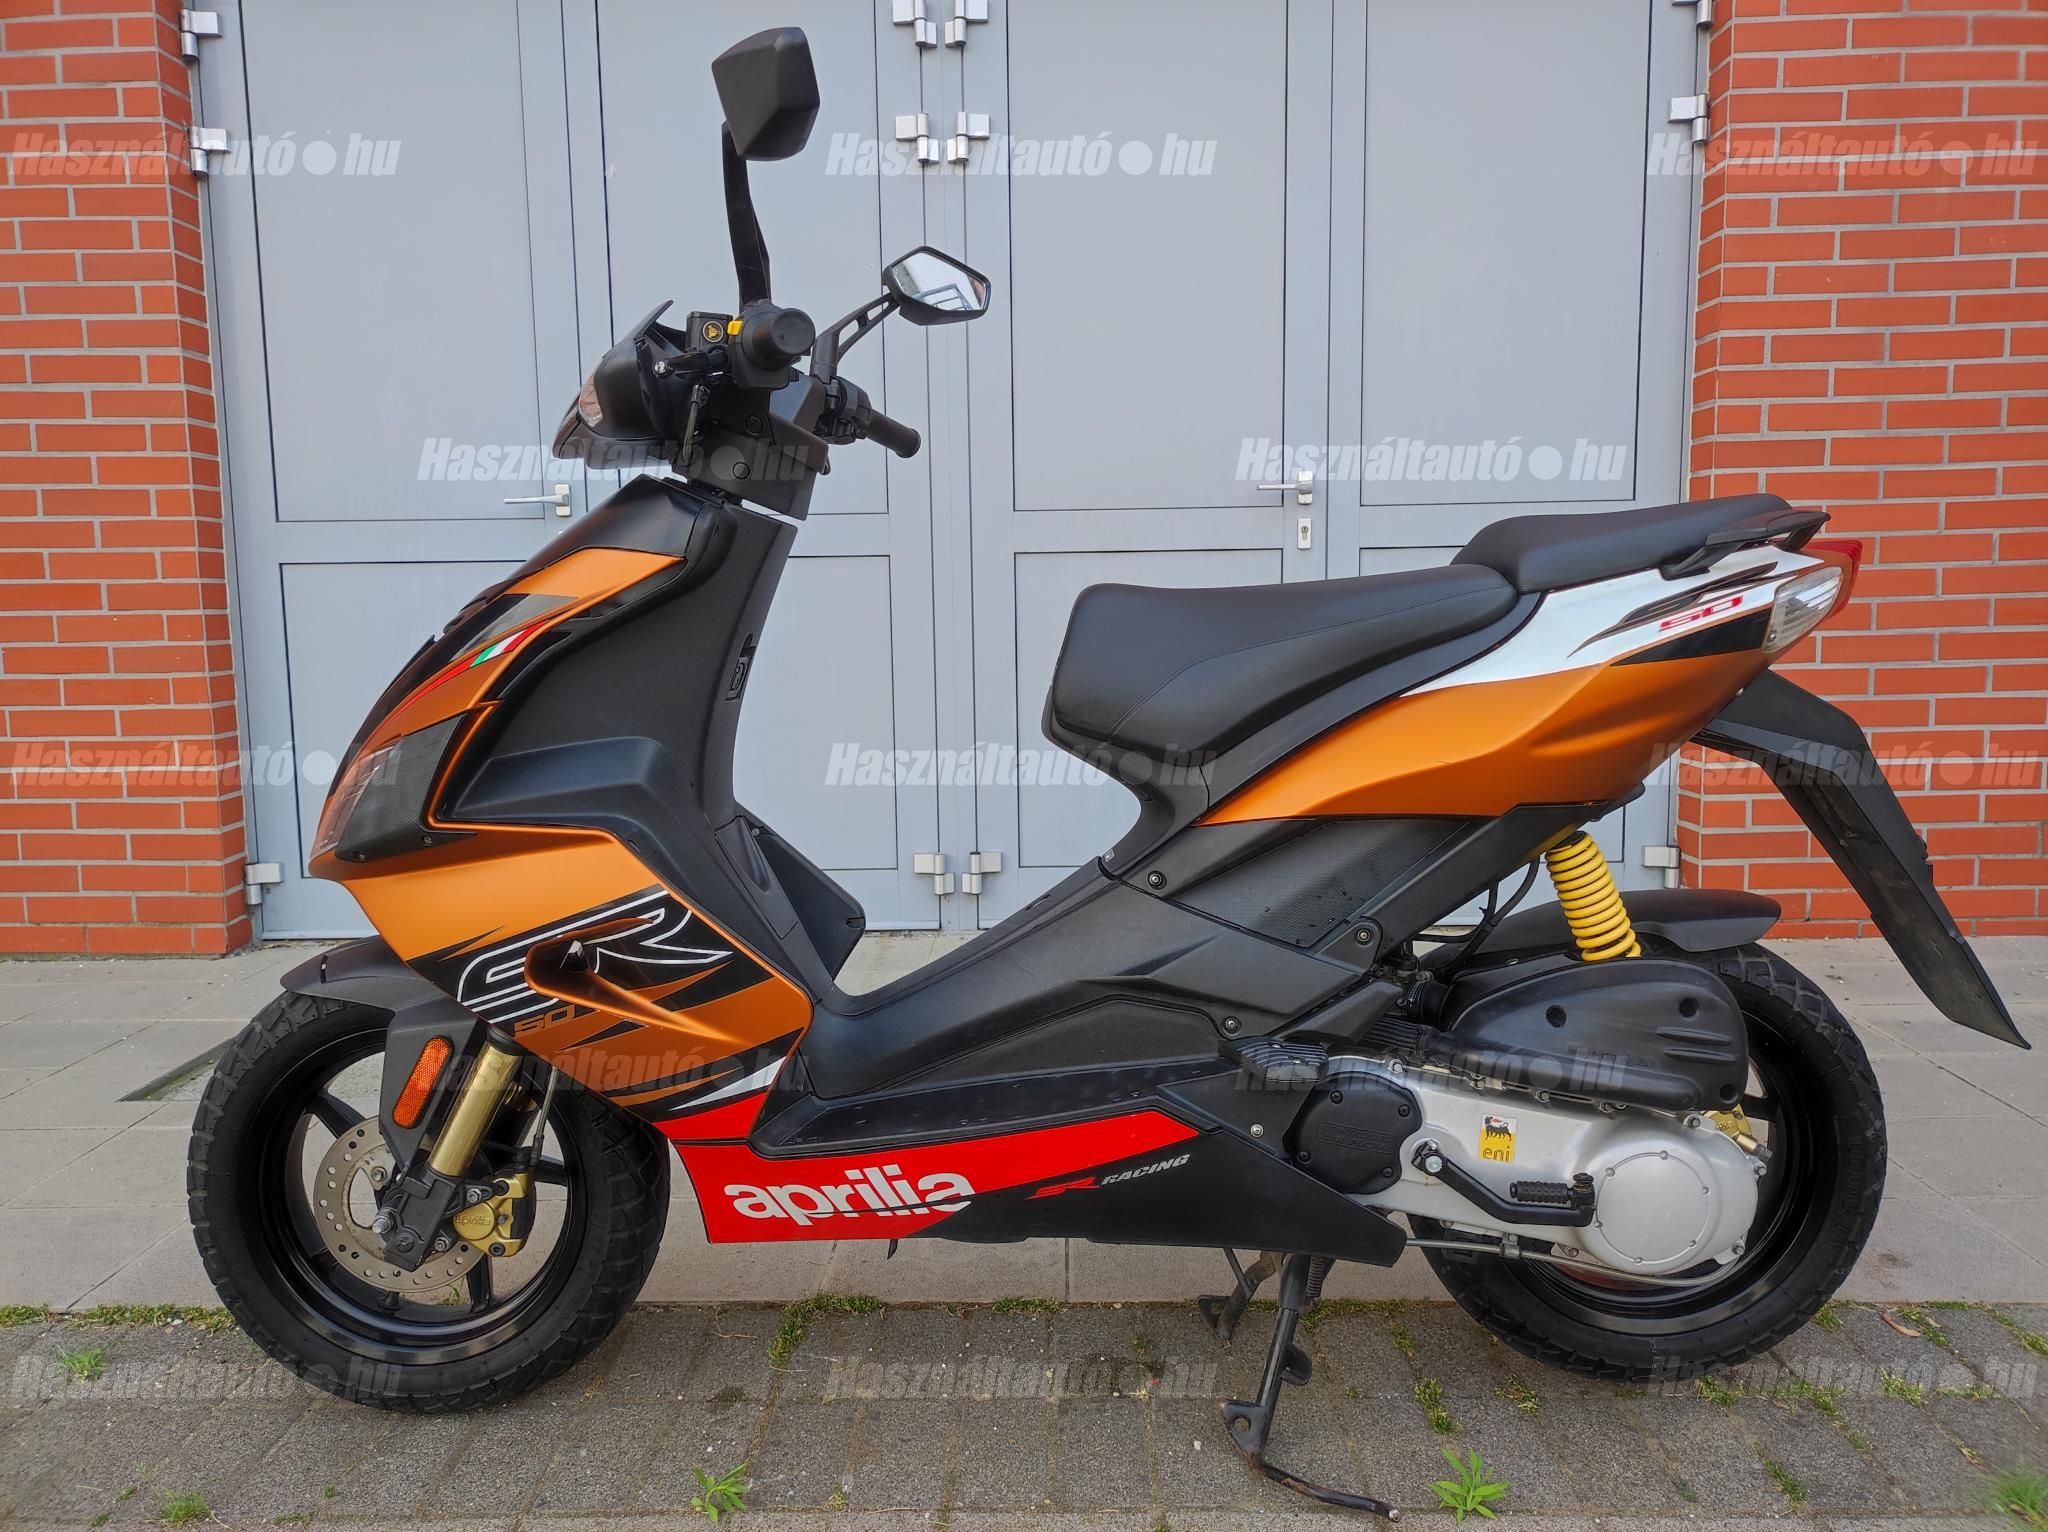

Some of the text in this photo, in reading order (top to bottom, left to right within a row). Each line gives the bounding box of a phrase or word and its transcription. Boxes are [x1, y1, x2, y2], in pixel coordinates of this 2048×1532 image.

[514, 1004, 576, 1038] 50
[1100, 1153, 1191, 1186] RACING
[1482, 1145, 1512, 1162] eni
[724, 1163, 976, 1226] aprilia
